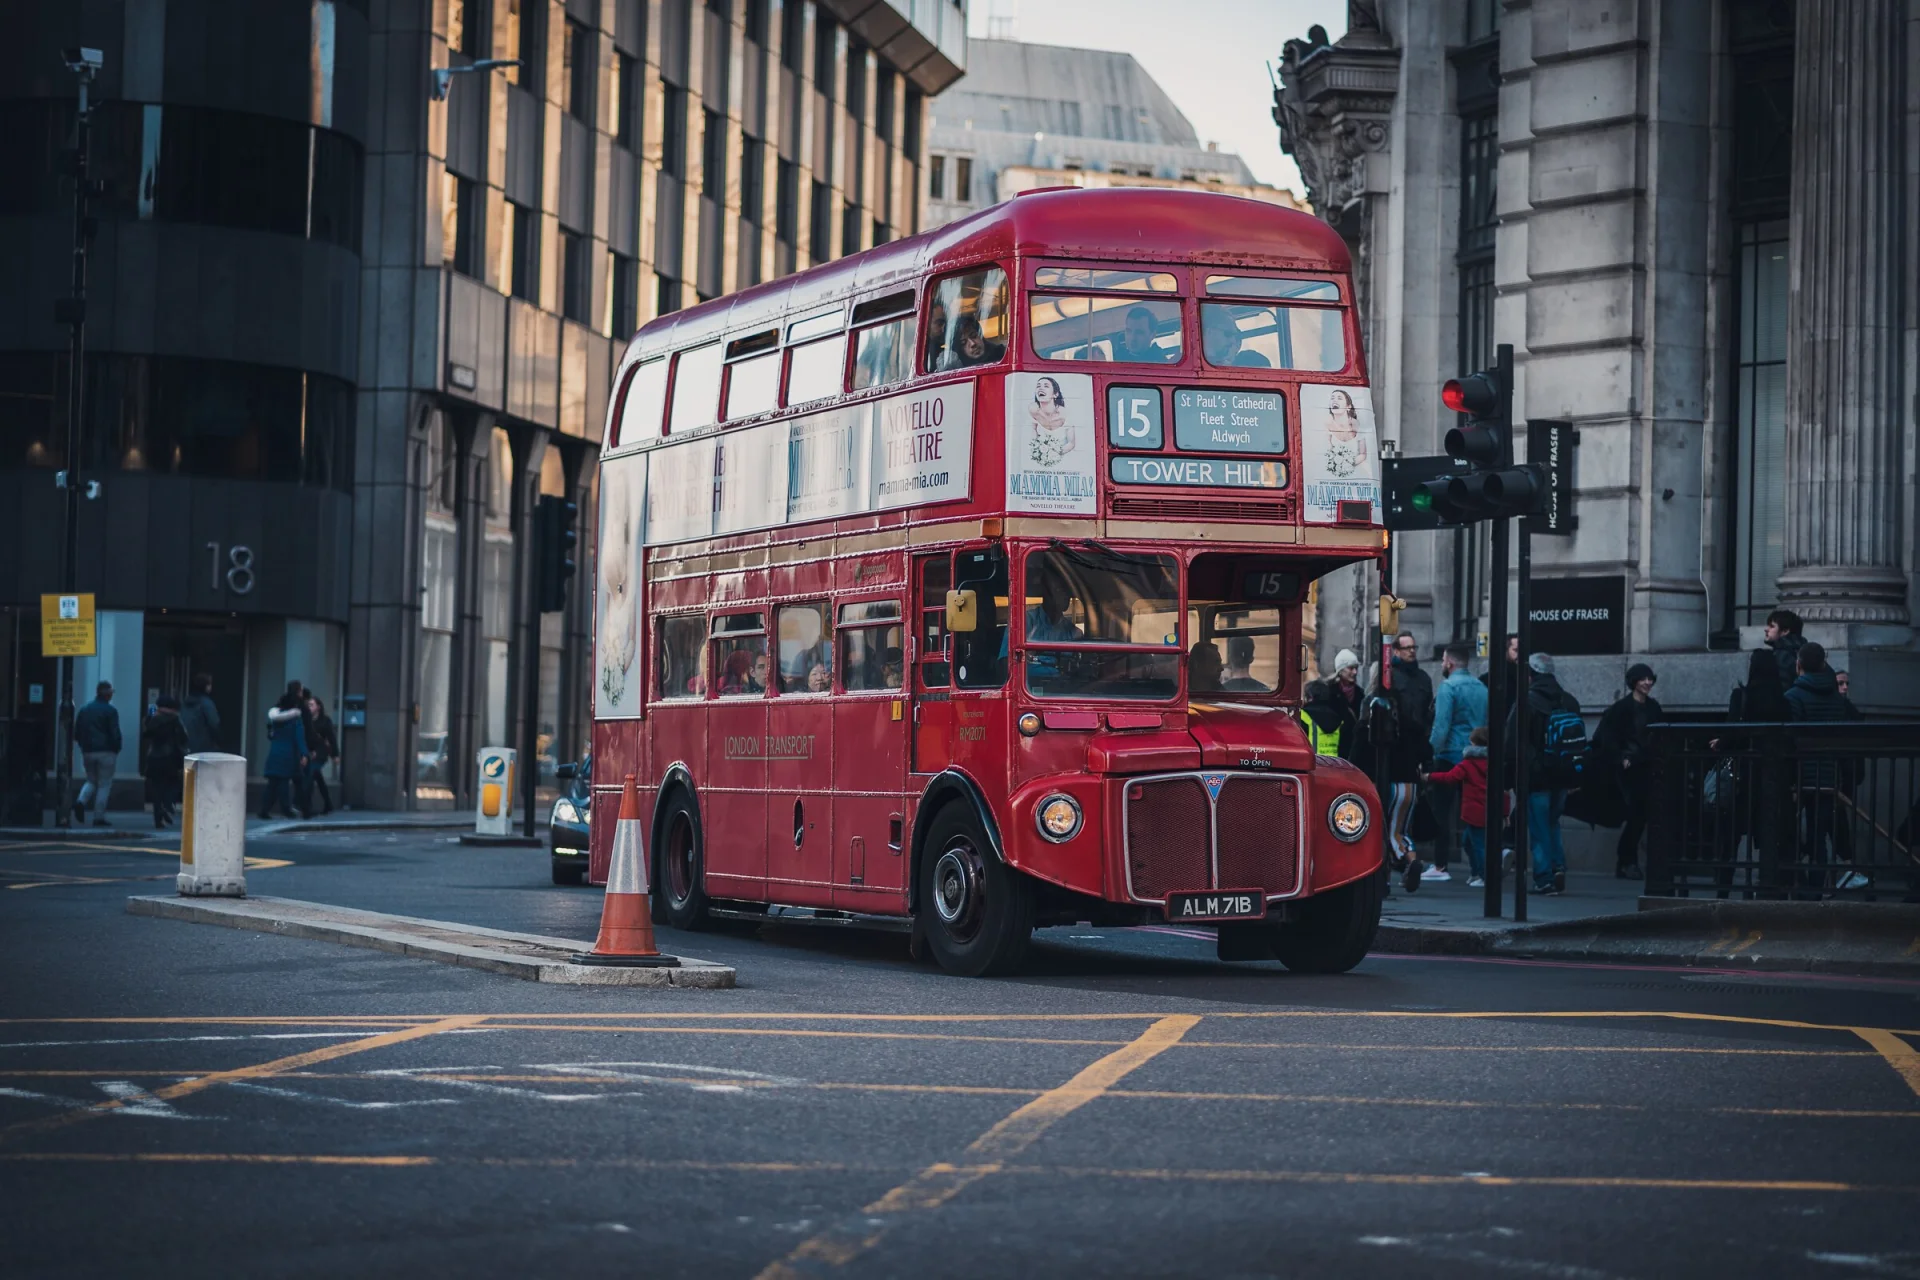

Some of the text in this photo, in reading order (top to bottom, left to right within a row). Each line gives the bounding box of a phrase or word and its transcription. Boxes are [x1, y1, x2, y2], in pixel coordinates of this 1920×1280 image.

[1181, 394, 1277, 411] St Paul's Cathedral
[887, 397, 944, 435] NOVELLO
[1117, 398, 1151, 438] 15
[1200, 412, 1259, 427] Fleet Street
[887, 431, 943, 469] THEATRE
[1211, 431, 1250, 447] Aldwych
[1550, 427, 1558, 467] FRASER
[1128, 460, 1272, 485] TOWER HILL
[1010, 473, 1094, 497] MAMMA MIA!
[207, 542, 254, 593] 18
[1260, 573, 1281, 594] 15
[1529, 609, 1609, 621] HOUSE OF FRASER
[960, 726, 986, 741] RM2071
[724, 735, 815, 759] LONDON TRANSPORT
[1183, 897, 1252, 915] ALM 71B
